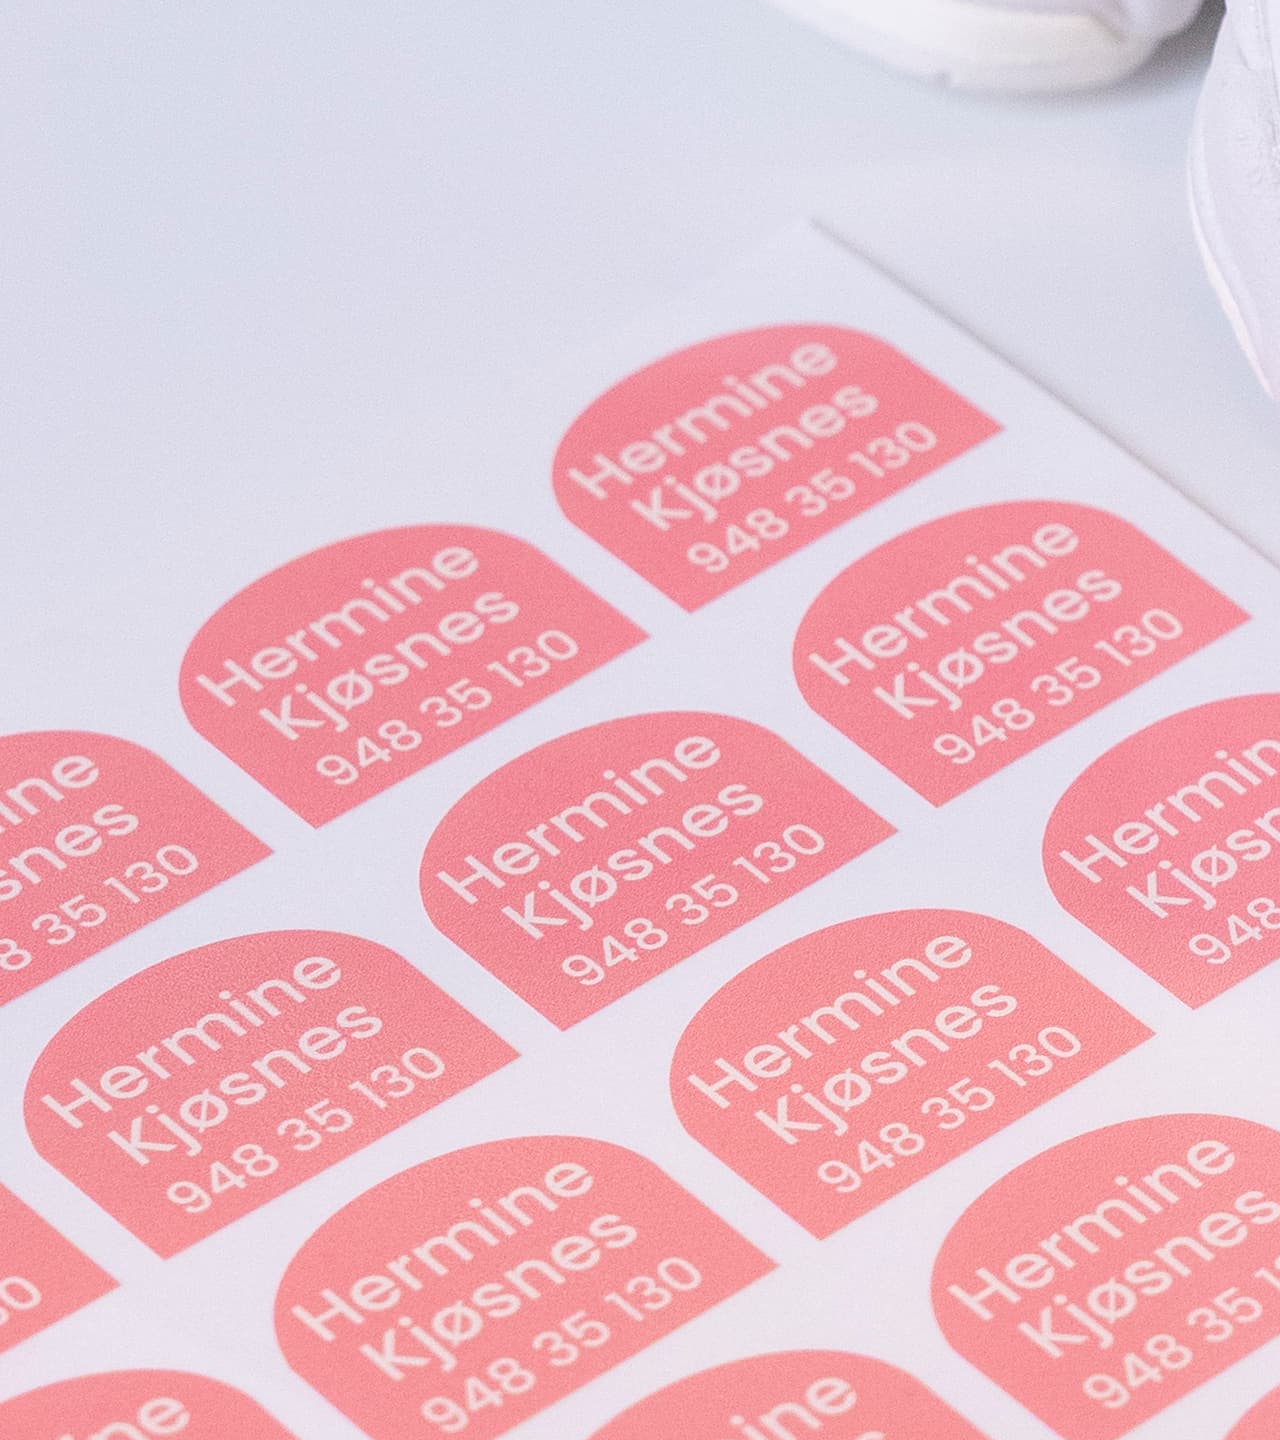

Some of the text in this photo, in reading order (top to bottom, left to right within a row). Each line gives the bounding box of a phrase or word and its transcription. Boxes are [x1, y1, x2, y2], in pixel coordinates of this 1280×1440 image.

[195, 545, 479, 707] Hermine
[257, 591, 520, 741] Kjøsnes
[808, 522, 1079, 686] Hermine
[871, 569, 1122, 720] Kjøsnes
[314, 629, 579, 786] 948 35 130
[931, 607, 1184, 765] 948 35 130
[41, 955, 342, 1130] Hermine
[106, 1004, 384, 1166] Kjøsnes
[686, 934, 973, 1109] Hermine
[753, 983, 1018, 1145] Kjøsnes
[165, 1046, 446, 1215] 948 35 130
[816, 1024, 1082, 1194] 948 35 130
[948, 1138, 1236, 1321] Hermine
[1082, 1332, 1193, 1409] 948
[1186, 1286, 1263, 1343] 35
